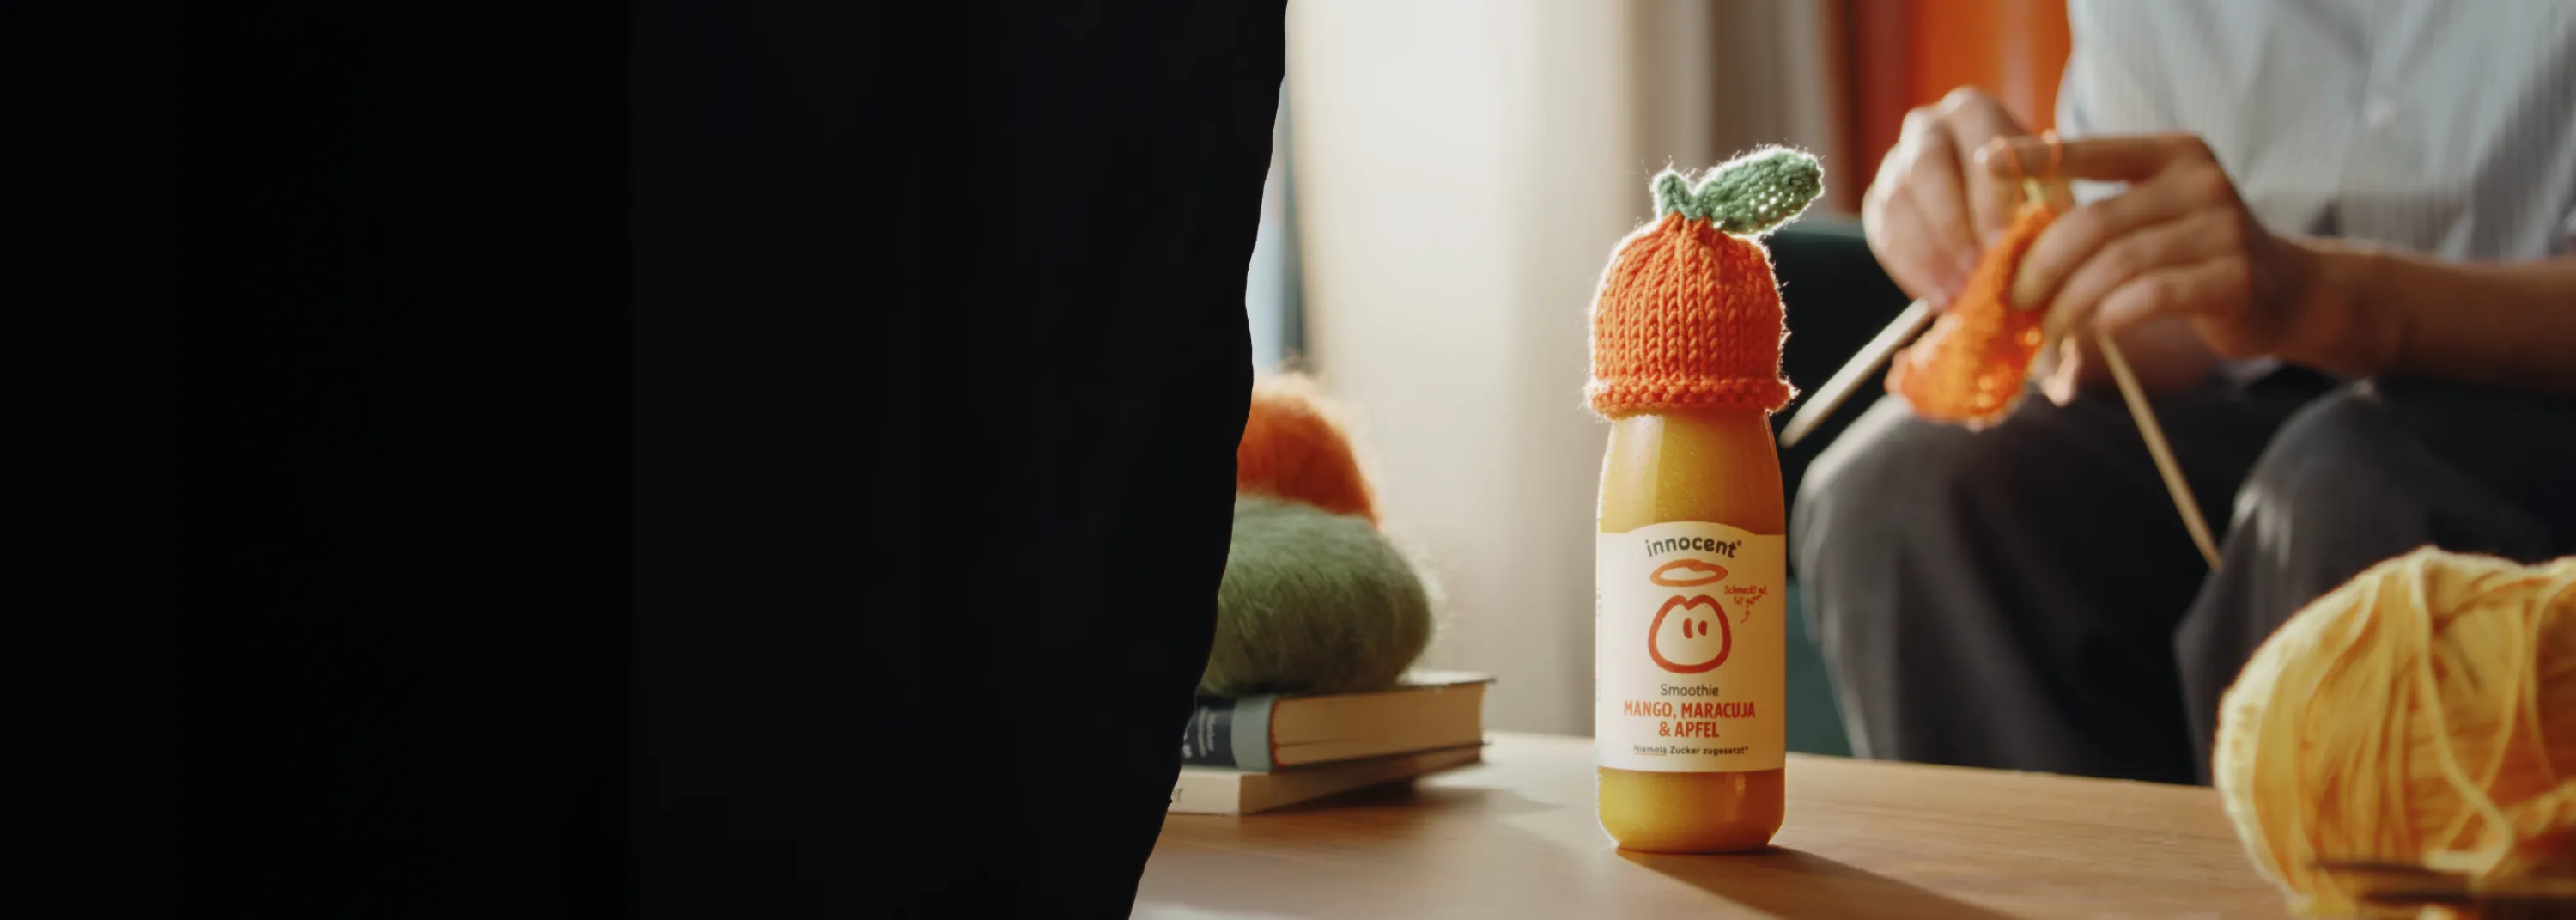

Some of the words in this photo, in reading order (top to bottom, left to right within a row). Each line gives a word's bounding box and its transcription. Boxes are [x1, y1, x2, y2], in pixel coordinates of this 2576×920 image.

[1661, 684, 1719, 697] Smoothie
[1624, 700, 1677, 719] MANGO,
[1680, 702, 1756, 719] MARACUJA
[1658, 721, 1671, 737] &
[1674, 721, 1720, 738] APFEL
[1633, 746, 1668, 754] Niemals
[1670, 746, 1699, 754] Zucker
